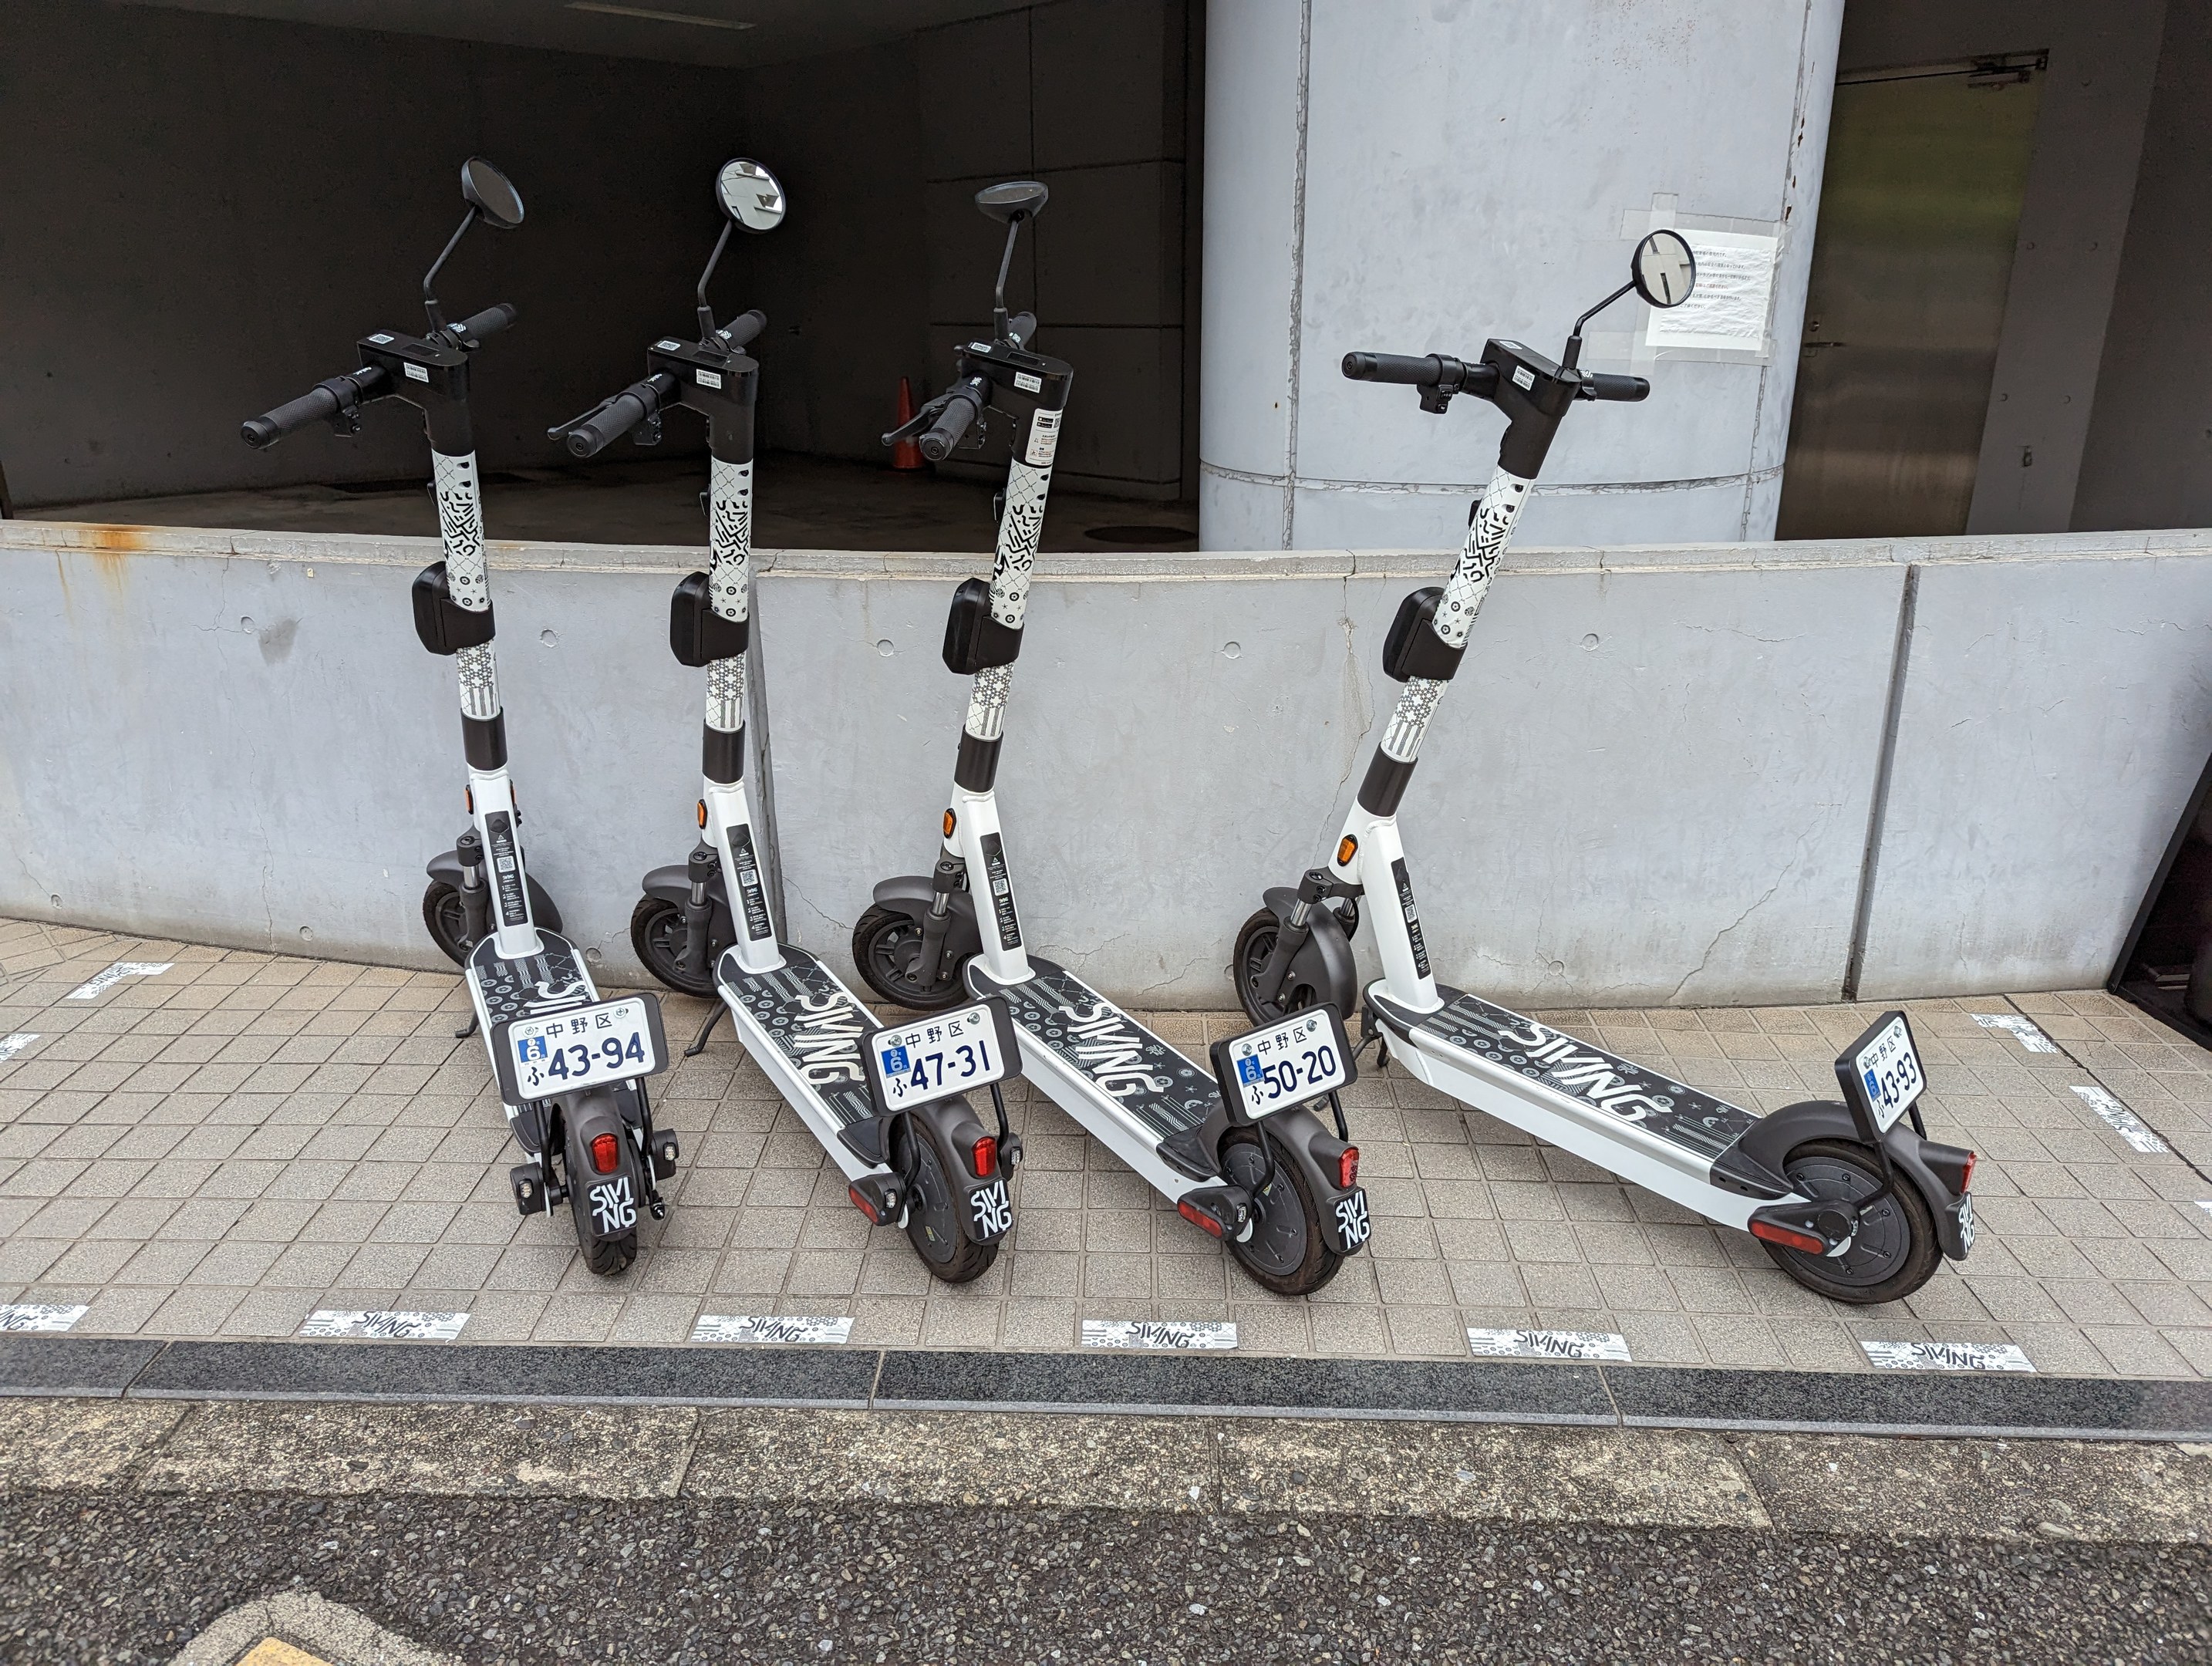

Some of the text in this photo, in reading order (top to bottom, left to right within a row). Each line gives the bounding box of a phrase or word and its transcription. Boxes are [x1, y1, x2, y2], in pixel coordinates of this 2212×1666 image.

[546, 1013, 612, 1039] 中野区
[905, 1020, 964, 1048] 中野区
[1257, 1026, 1307, 1055] 中野区
[1871, 1036, 1897, 1067] 中野区
[527, 1031, 645, 1086] ふ 43-94
[893, 1040, 990, 1098] ふ 47-31
[1498, 1023, 1673, 1121] SWING
[1251, 1045, 1337, 1105] ふ 50-20
[1880, 1052, 1917, 1109] 43-93
[351, 1311, 422, 1337] SWING
[739, 1316, 809, 1342] SWING
[1125, 1321, 1195, 1348] SWING
[1513, 1330, 1584, 1358] SWING
[1910, 1342, 1986, 1370] SWING
